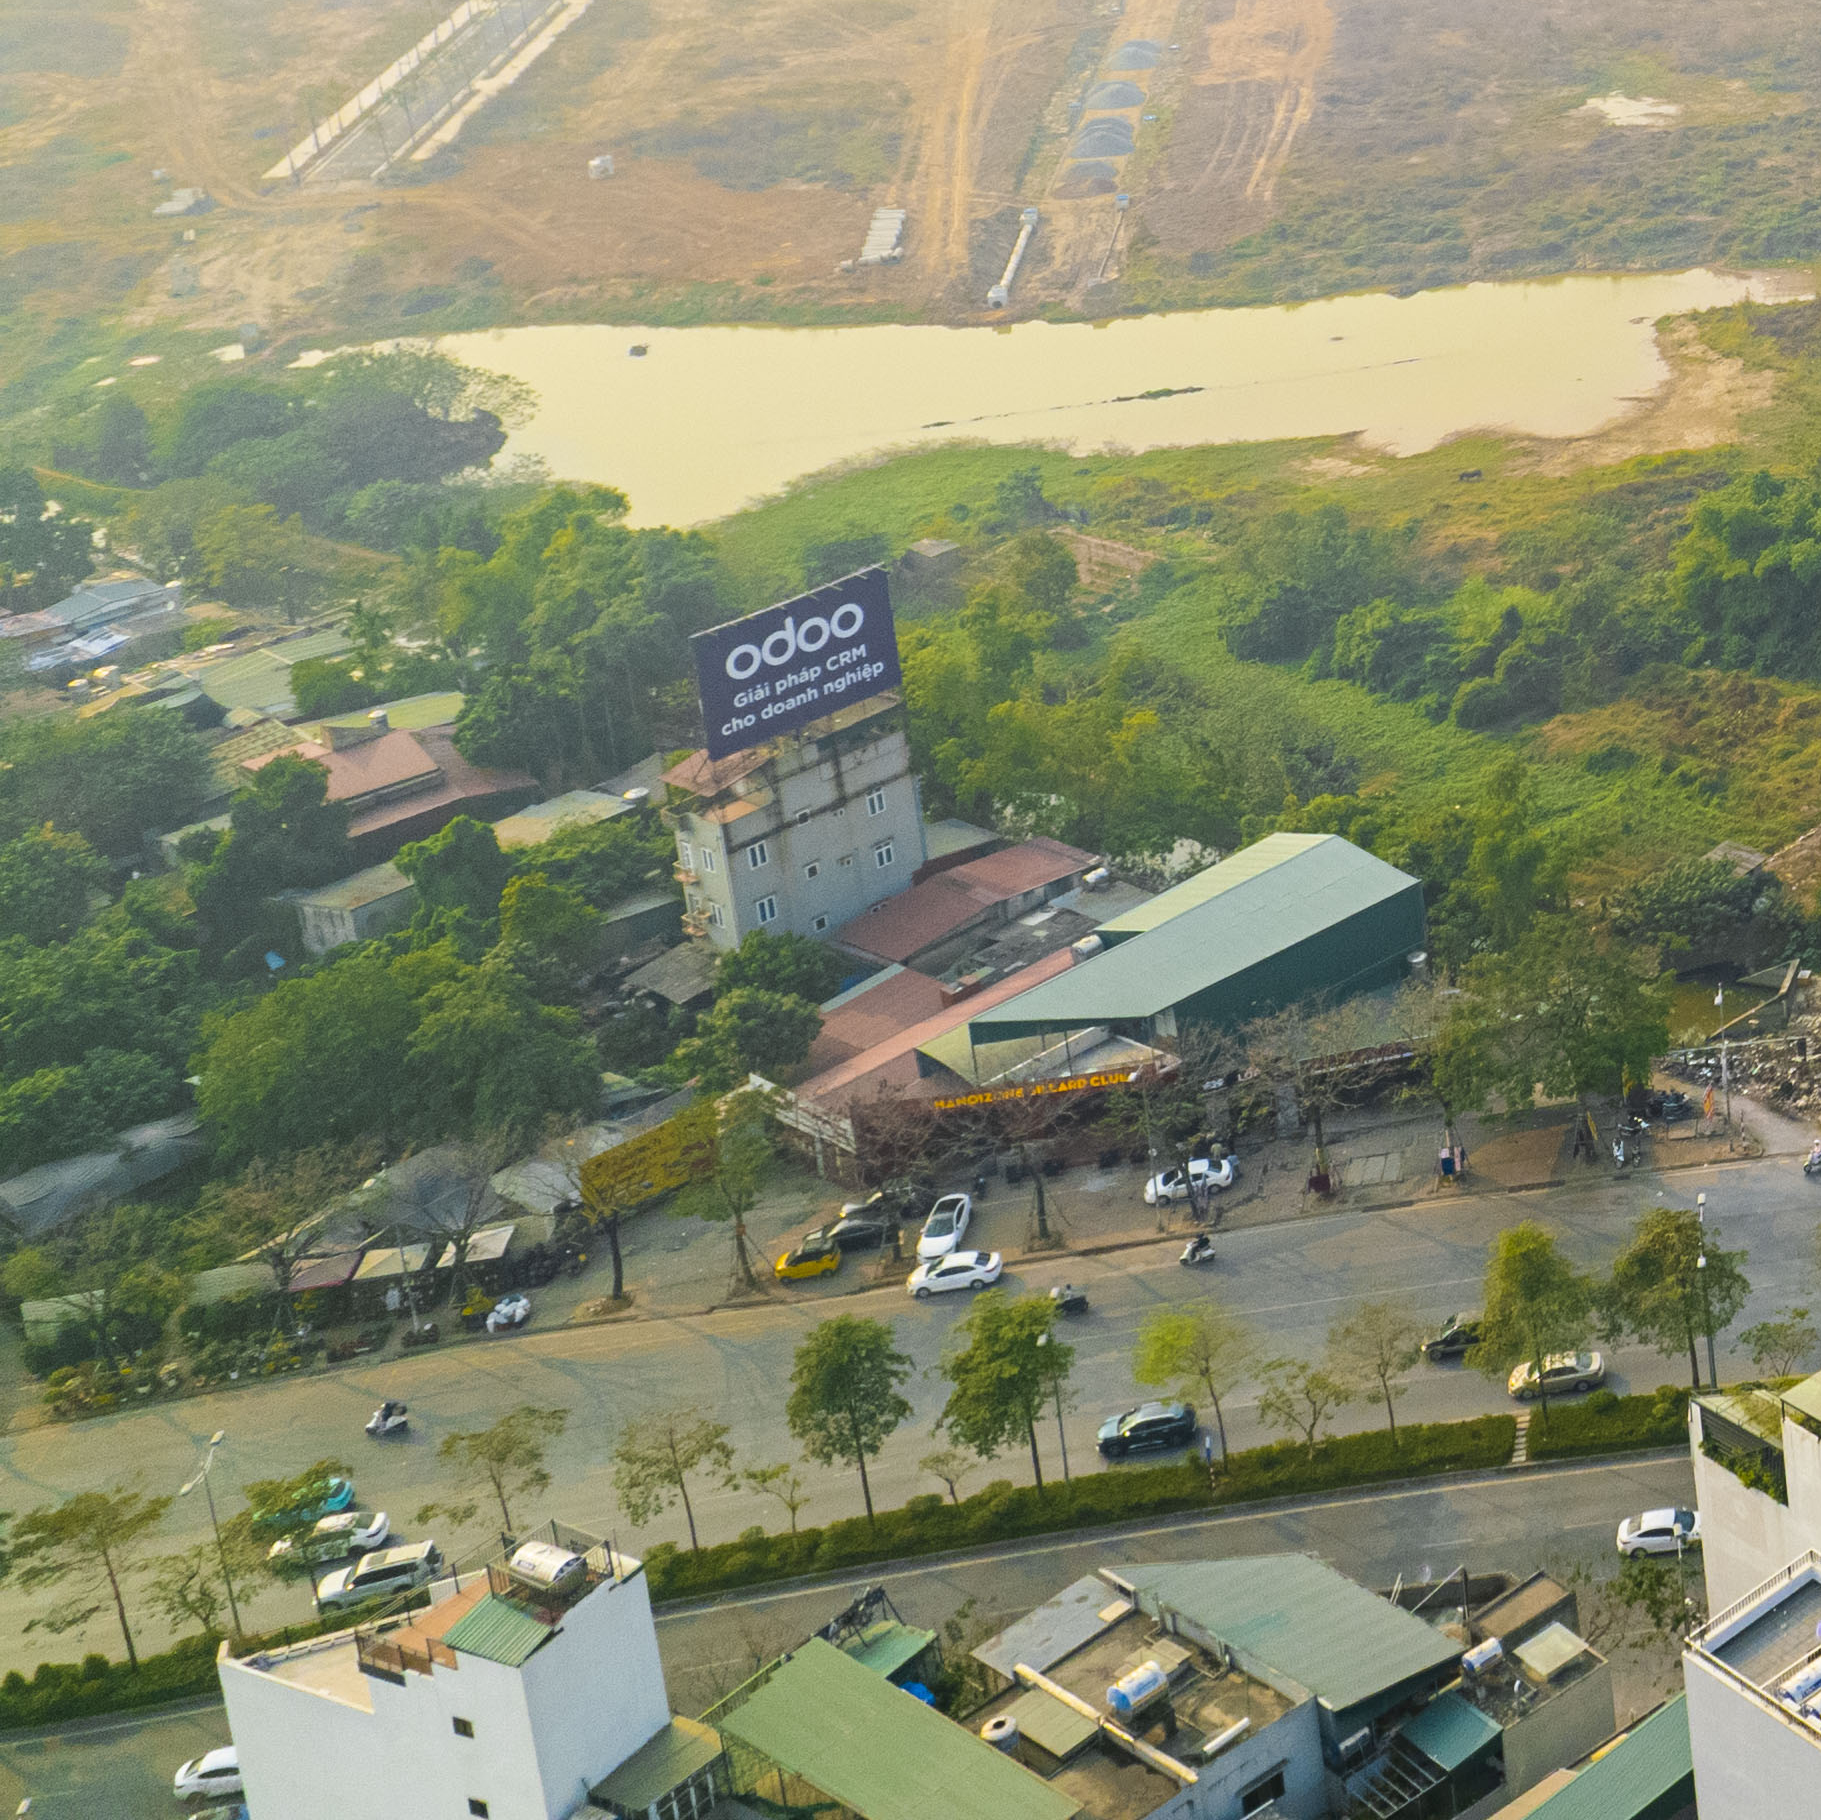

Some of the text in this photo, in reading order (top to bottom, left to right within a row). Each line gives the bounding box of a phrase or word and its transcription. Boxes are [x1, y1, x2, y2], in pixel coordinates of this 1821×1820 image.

[726, 603, 864, 680] odoo
[733, 644, 867, 708] Giải pháp CRM
[721, 661, 884, 736] cho doanh nghiệp
